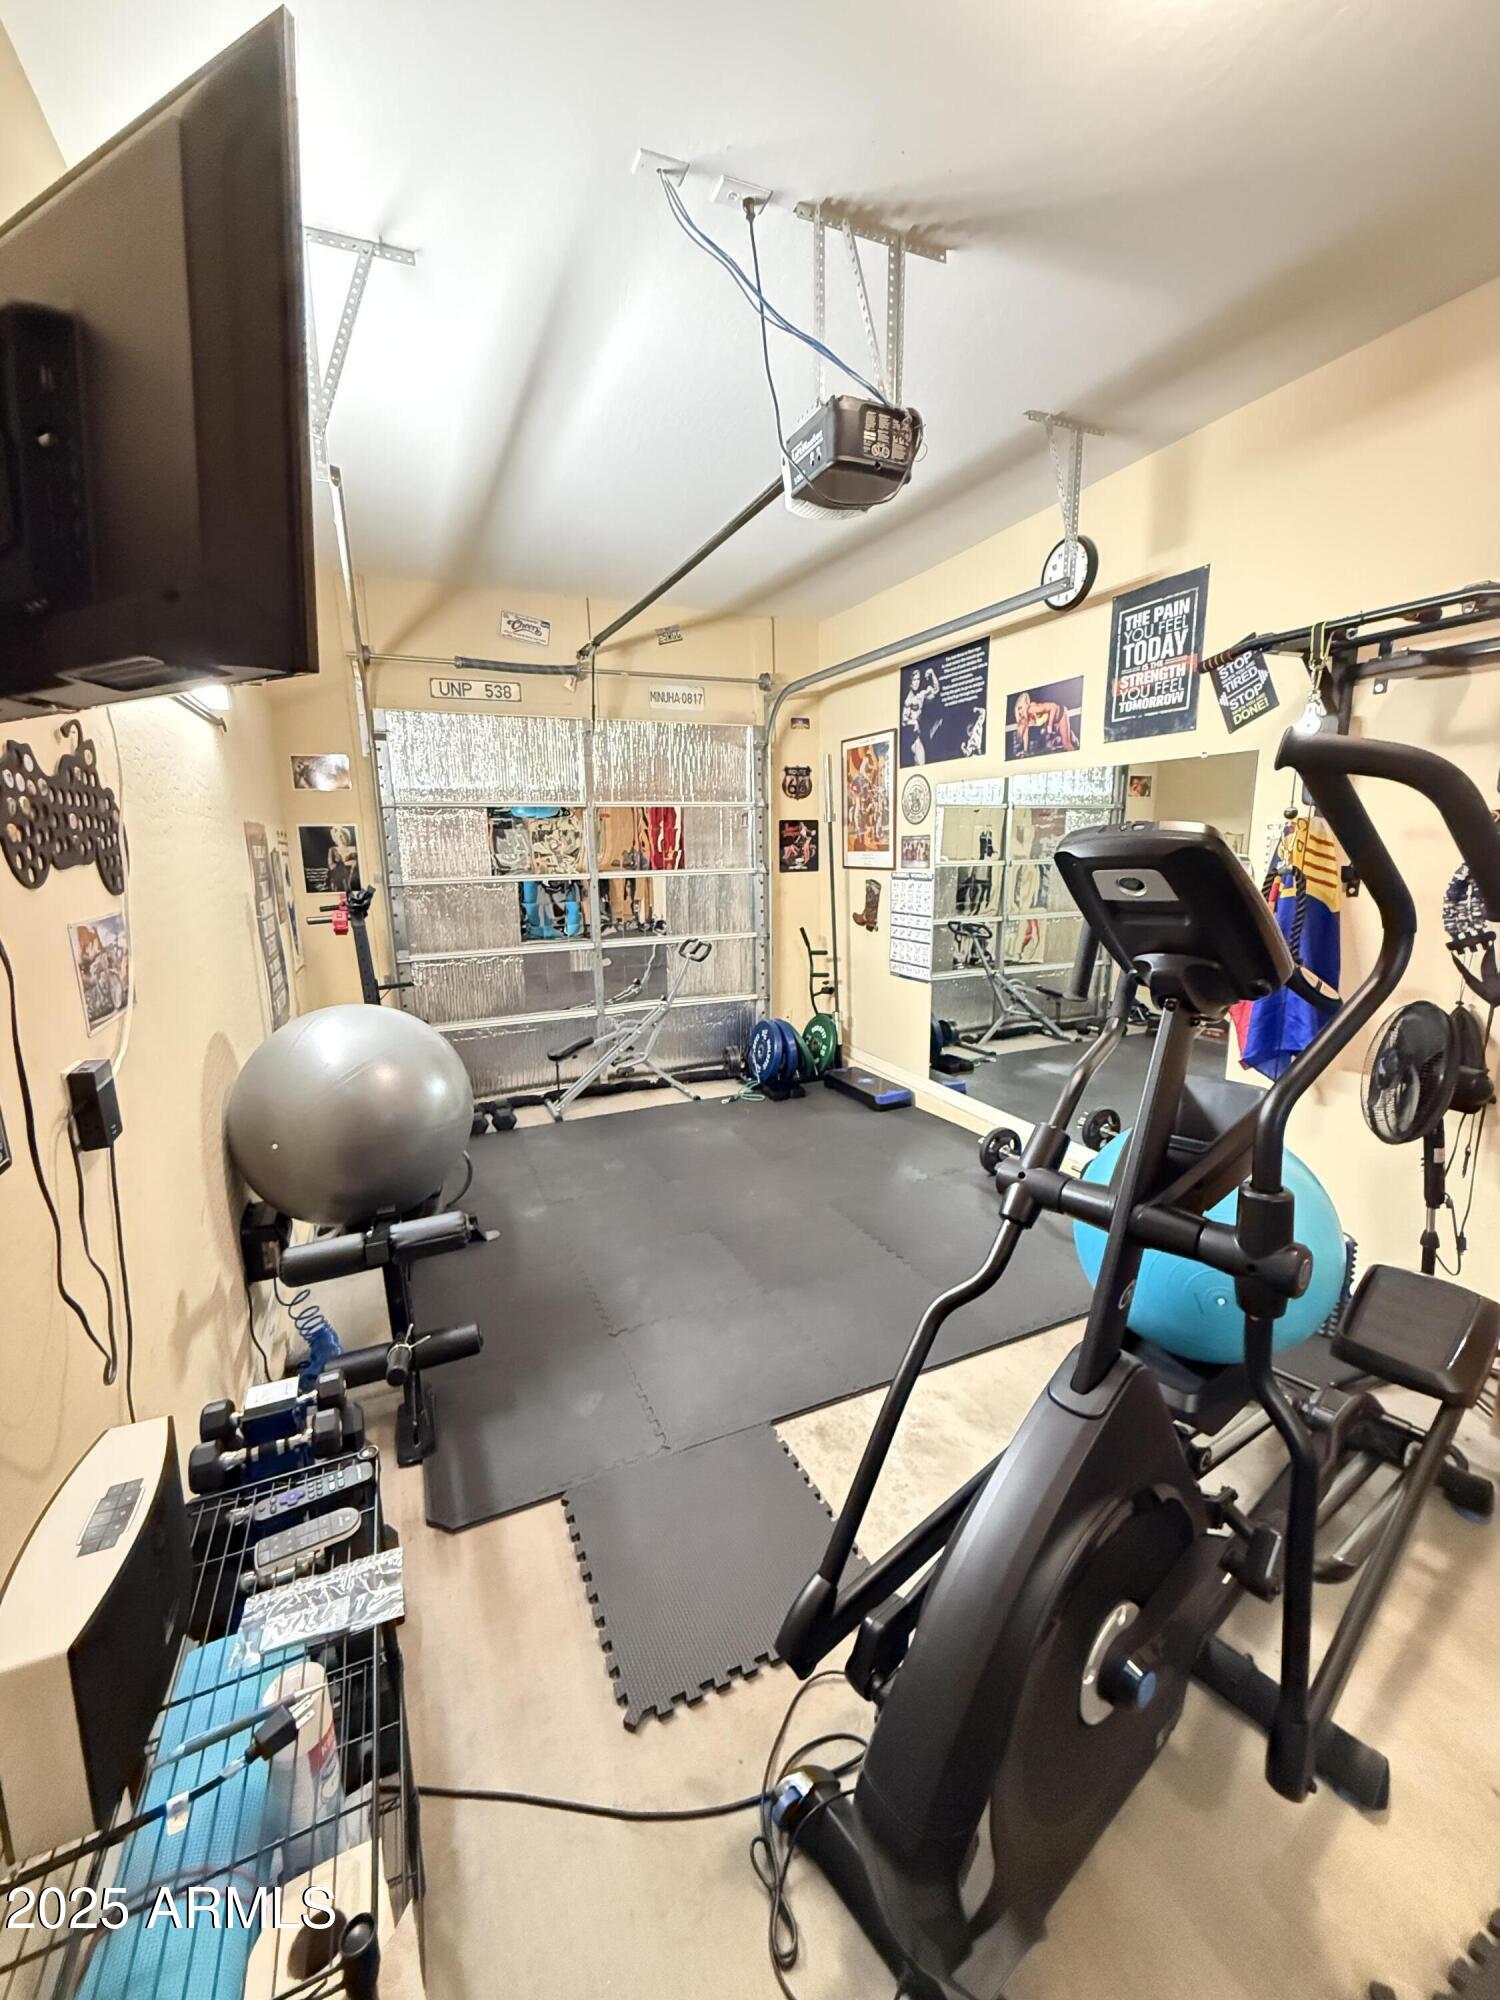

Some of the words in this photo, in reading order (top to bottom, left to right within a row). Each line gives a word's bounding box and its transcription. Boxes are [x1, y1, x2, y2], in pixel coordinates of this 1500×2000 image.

[1124, 610, 1151, 631] THE
[1153, 597, 1191, 623] PAIN
[1123, 623, 1154, 644] YOU
[1158, 614, 1189, 635] FEEL
[1122, 628, 1189, 668] TODAY
[1119, 662, 1187, 689] STRENGTH
[1218, 650, 1253, 680] STOP
[439, 681, 472, 696] UNP
[484, 684, 512, 699] 538
[1119, 684, 1151, 701] YOU
[1154, 677, 1185, 696] FEEL
[1222, 666, 1258, 693] TIRED
[1118, 690, 1185, 713] TOMORROW
[1229, 683, 1263, 711] STOP
[1232, 697, 1269, 725] DONE!
